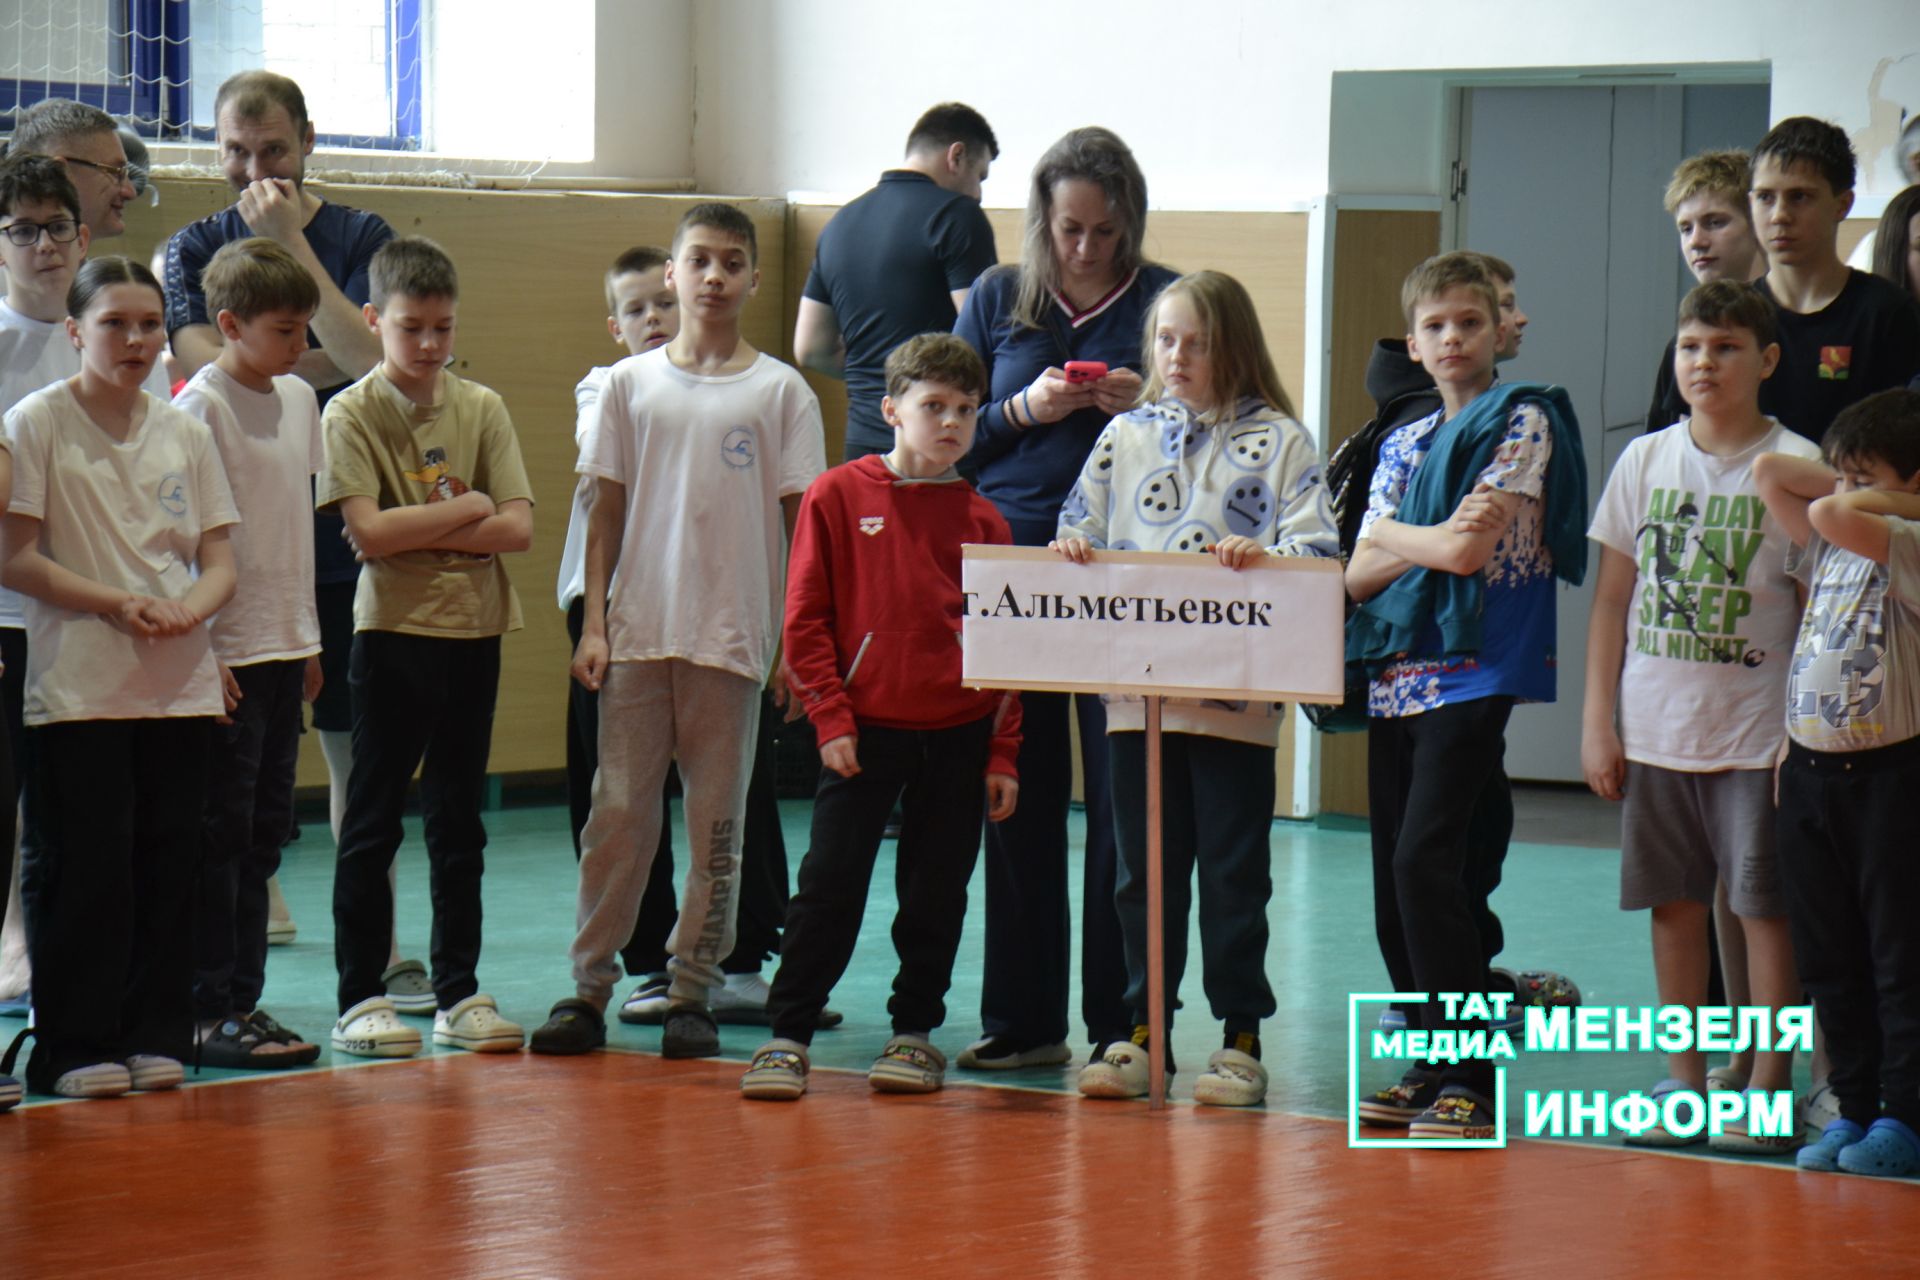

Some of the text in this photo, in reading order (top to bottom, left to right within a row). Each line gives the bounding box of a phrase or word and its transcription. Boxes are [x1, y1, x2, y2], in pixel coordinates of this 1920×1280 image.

[1649, 488, 1767, 530] ALL DAY
[962, 583, 1272, 627] г.Альметьевск
[1635, 627, 1749, 664] ALL NIGHT
